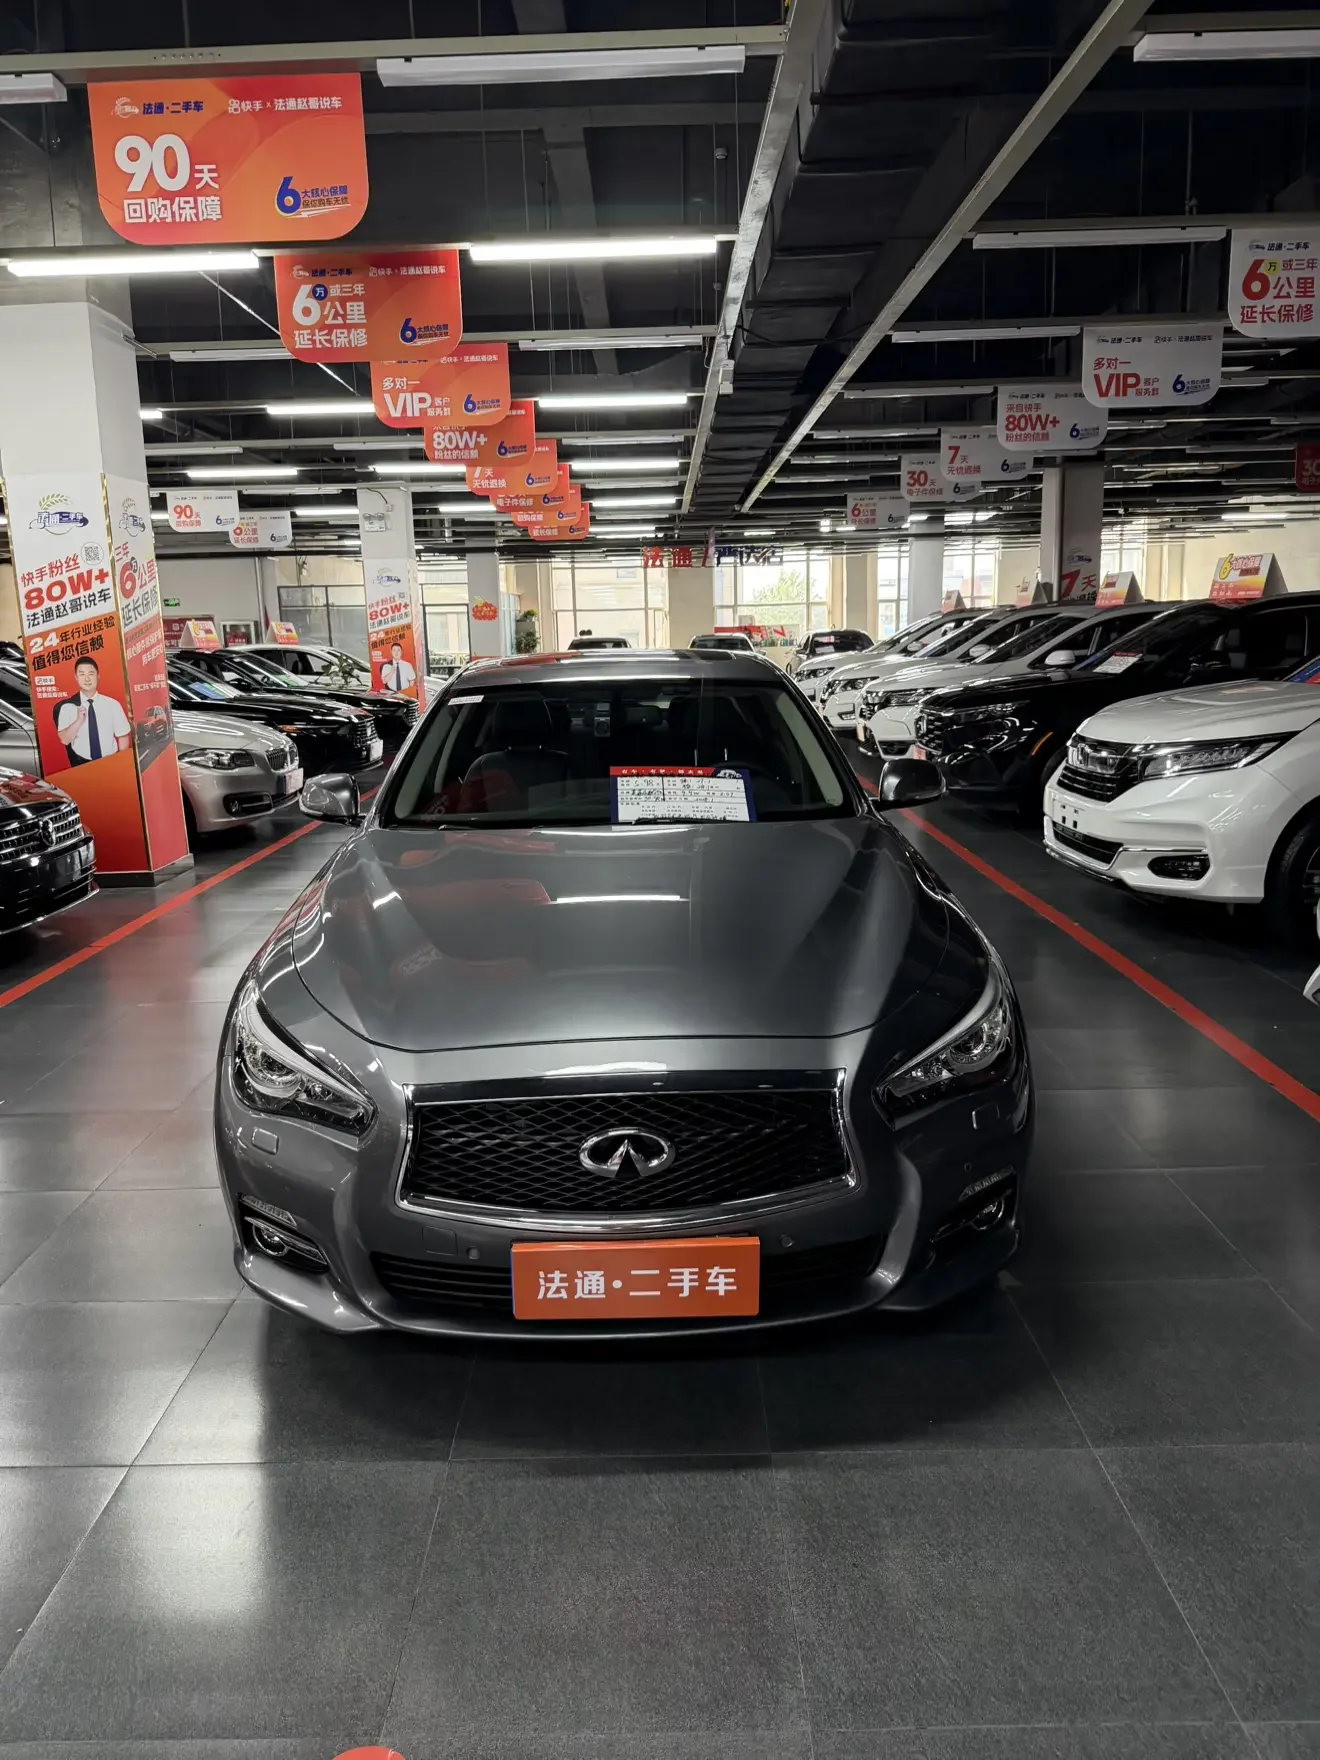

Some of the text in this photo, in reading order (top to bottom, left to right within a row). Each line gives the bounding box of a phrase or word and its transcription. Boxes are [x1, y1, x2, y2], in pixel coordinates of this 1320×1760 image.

[142, 101, 204, 115] 法通·二手车
[240, 99, 263, 113] 快手
[273, 96, 342, 111] 法通赵哥说车
[123, 194, 222, 224] 回购保障
[1282, 258, 1318, 272] 或三年
[329, 284, 365, 297] 或三年
[1273, 276, 1315, 299] 公里
[323, 301, 367, 324] 公里
[1240, 304, 1314, 324] 延长保修
[293, 328, 368, 349] 延长保修
[1093, 357, 1131, 371] 多对一
[382, 377, 420, 391] 多对一
[1093, 373, 1141, 398] VIP
[384, 392, 432, 417] VIP
[1005, 414, 1060, 432] 80W+
[432, 431, 488, 450] 80W+
[20, 553, 81, 588] 快手粉丝
[24, 568, 109, 610] 80W+
[26, 588, 112, 629] 法通赵哥说车
[121, 585, 159, 629] 延长保修
[369, 601, 409, 621] 80W+
[29, 616, 115, 654] 24年行业经验
[32, 634, 105, 672] 值得您信赖
[537, 1266, 738, 1300] 法通·二手车
